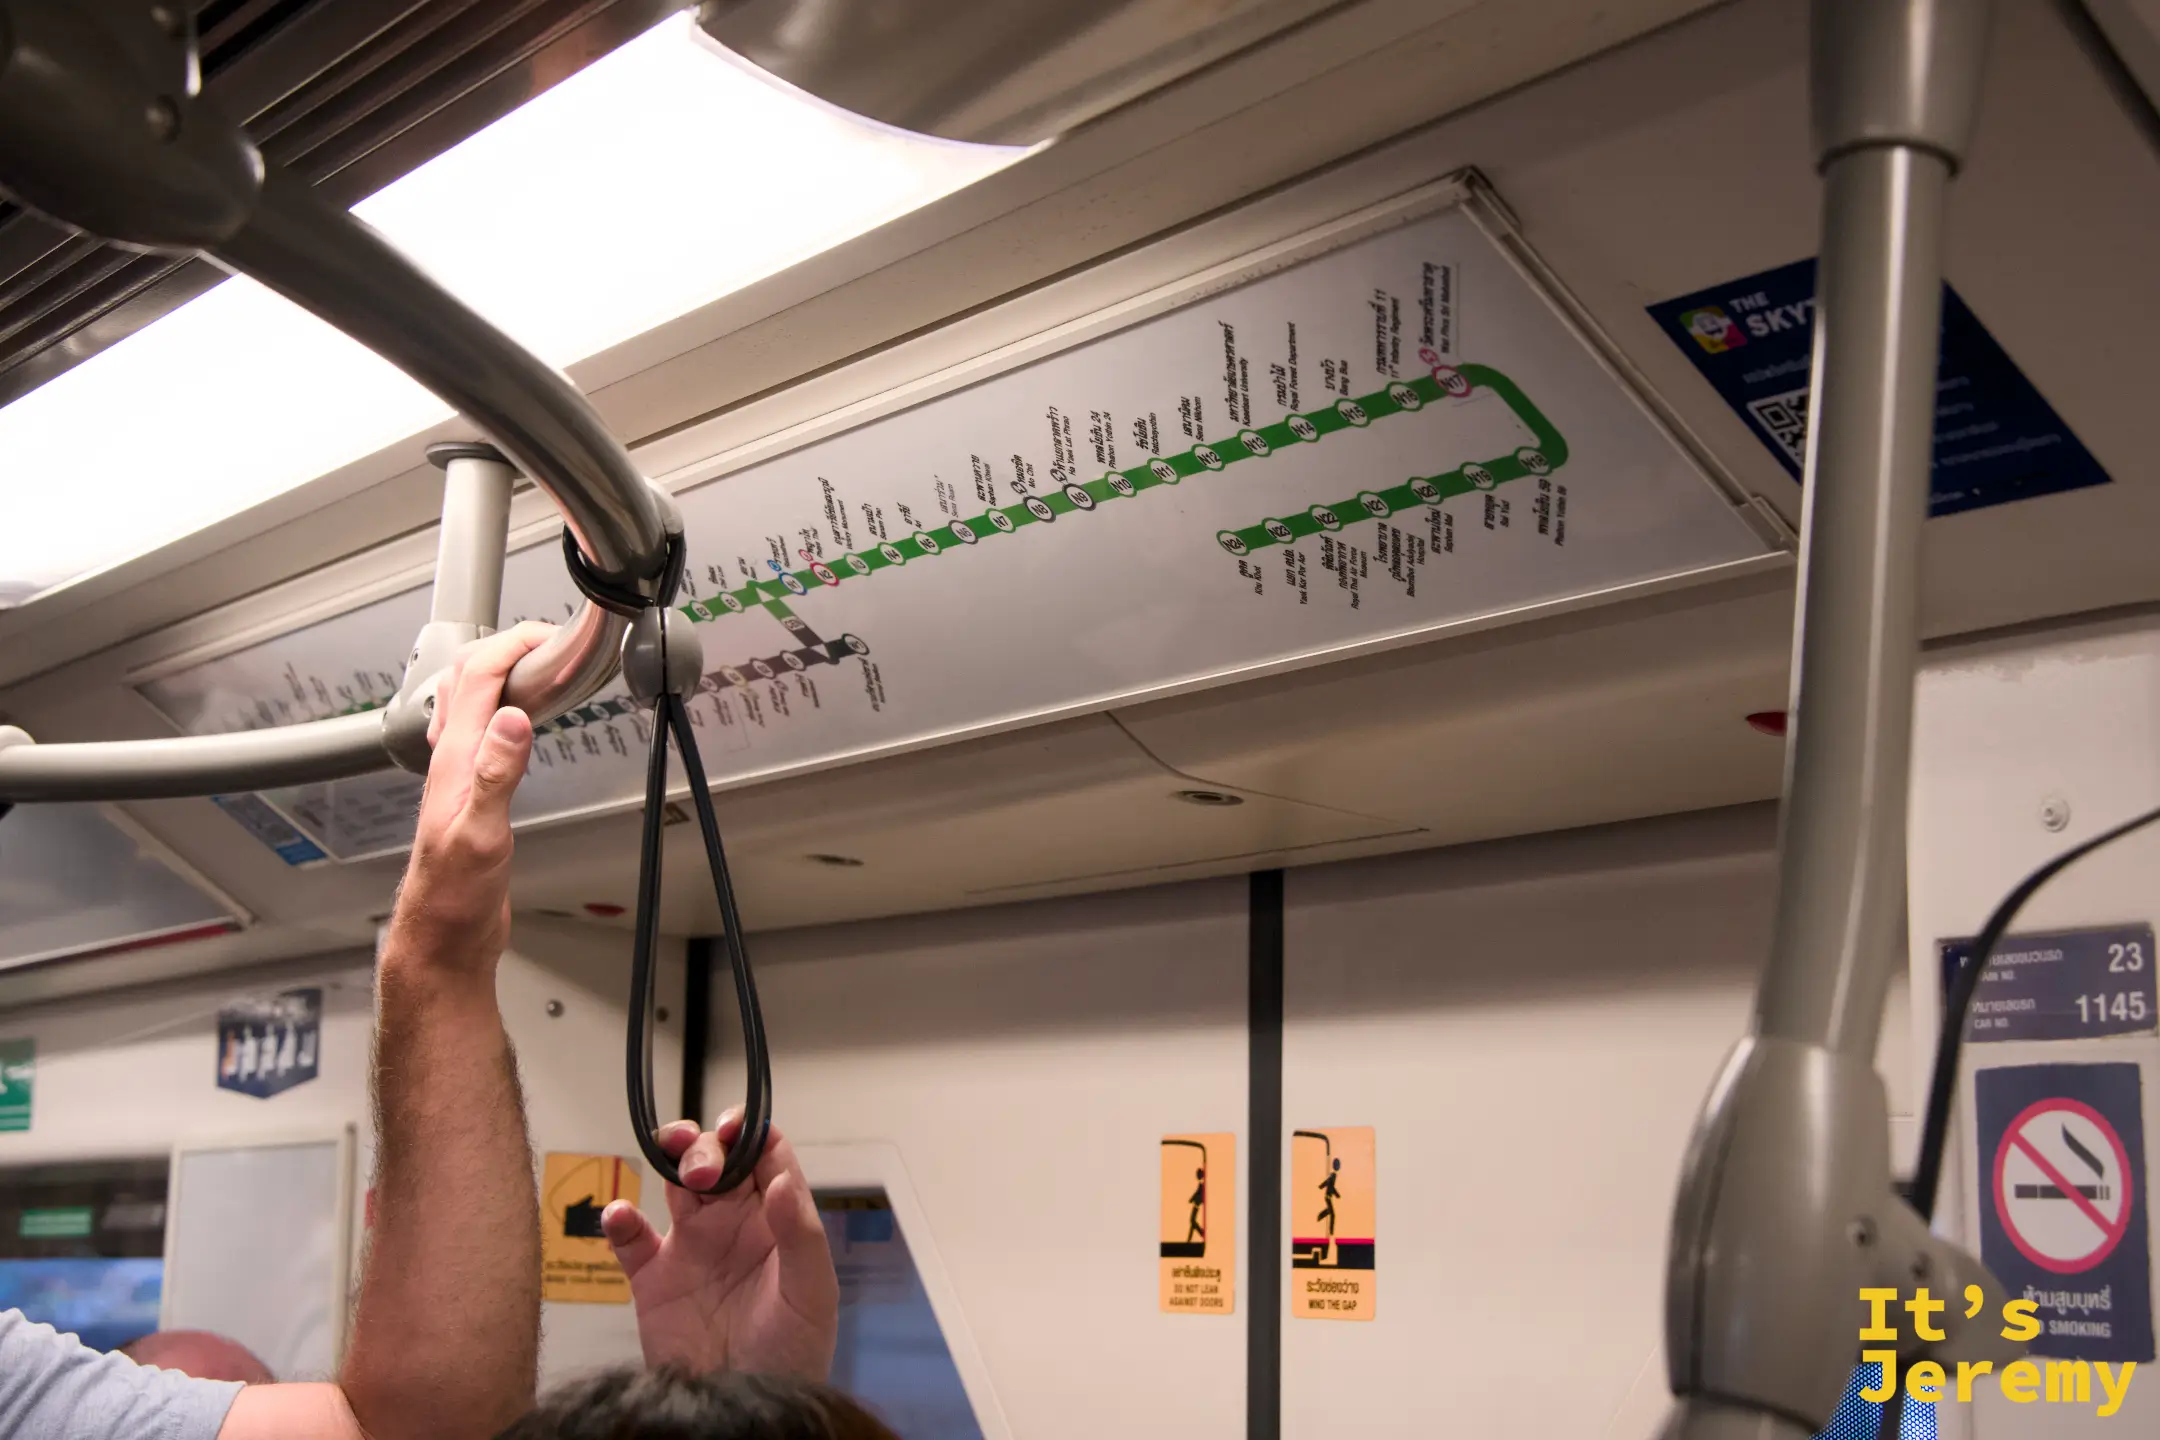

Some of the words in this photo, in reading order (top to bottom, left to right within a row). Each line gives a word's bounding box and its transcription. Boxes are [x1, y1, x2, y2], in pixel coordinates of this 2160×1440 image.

[1728, 291, 1770, 314] THE
[1287, 321, 1298, 365] Department
[1239, 357, 1248, 392] University
[1289, 366, 1298, 390] Forest
[1440, 374, 1464, 389] N17
[1339, 377, 1350, 396] Bang
[1290, 391, 1300, 412] Royal
[1392, 388, 1419, 407] N16
[1090, 410, 1101, 424] 24
[1103, 411, 1111, 421] 24
[1194, 396, 1203, 423] Nikhom
[1341, 405, 1366, 422] N15
[1063, 415, 1071, 436] Phrao
[1105, 422, 1113, 442] Yothin
[1291, 421, 1315, 437] N14
[1132, 417, 1149, 450] รัชโยธิน
[1148, 412, 1160, 456] Ratchayothin
[1089, 424, 1106, 464] พหลโยธิน
[1243, 437, 1267, 452] N13
[1066, 449, 1074, 465] Yaek
[1107, 444, 1116, 469] Phahon
[1197, 451, 1221, 466] N12
[1011, 454, 1026, 483] หมอชิต
[1026, 463, 1034, 477] Chit
[1068, 466, 1076, 476] Ha
[1152, 465, 1175, 480] N11
[971, 453, 986, 501] สะพานควาย
[1028, 477, 1036, 488] Mo
[1110, 478, 1132, 492] N10
[1413, 485, 1438, 500] N20
[987, 483, 996, 506] Saphan
[1071, 491, 1088, 504] N9
[1363, 499, 1387, 514] N21
[993, 515, 1008, 528] N7
[1314, 512, 1339, 526] N22
[956, 527, 972, 539] N6
[1268, 525, 1290, 538] N23
[919, 538, 936, 550] N5
[1221, 538, 1245, 551] N24
[1350, 566, 1358, 577] Air
[1299, 578, 1307, 590] Kor
[1350, 577, 1358, 591] Thai
[1299, 590, 1308, 605] Yaek
[1351, 591, 1360, 610] Royal
[2107, 942, 2143, 973] 23
[2075, 991, 2147, 1024] 1145
[1974, 1018, 1992, 1029] CAR
[1309, 1299, 1325, 1310] MIND
[1327, 1299, 1340, 1310] THE
[1342, 1300, 1358, 1311] GAP
[2048, 1318, 2112, 1339] SMOKING
